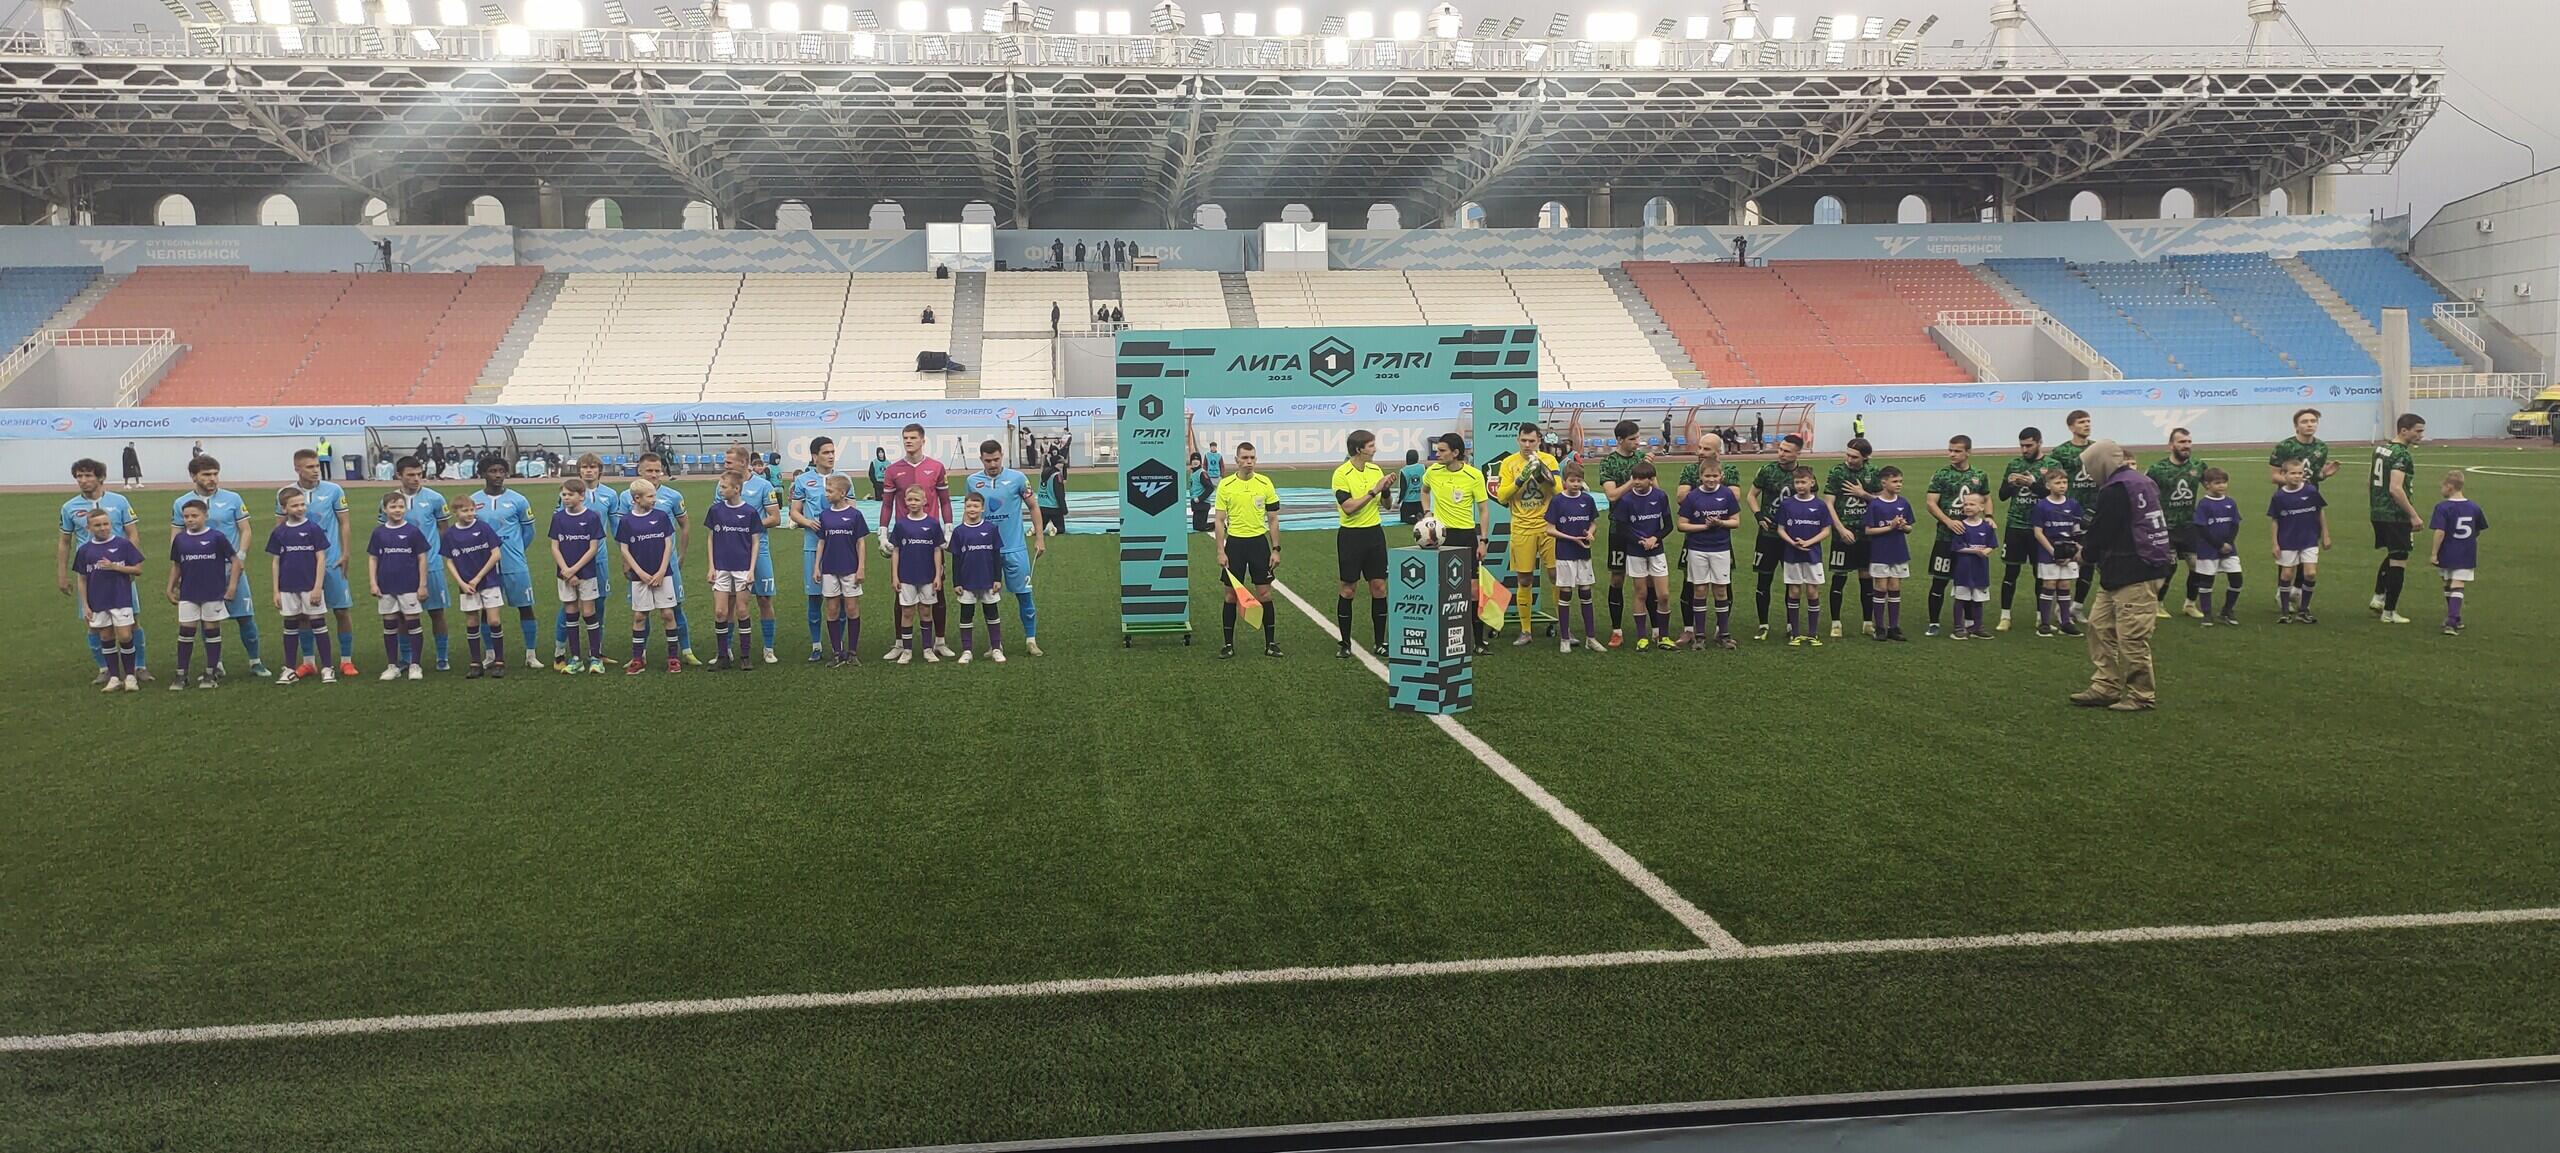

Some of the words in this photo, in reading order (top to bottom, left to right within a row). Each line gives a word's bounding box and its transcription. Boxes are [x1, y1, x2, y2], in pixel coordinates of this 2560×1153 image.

[1927, 243, 2003, 254] ЧЕЛЯБИНСК
[146, 249, 241, 260] ЧЕЛЯБИНСК
[1226, 354, 1302, 372] ЛИГА
[1362, 351, 1433, 370] PARI
[2036, 390, 2083, 401] Уралсиб
[2193, 388, 2239, 399] Уралсиб
[2343, 386, 2383, 396] Уралси
[1880, 393, 1926, 404] Уралсиб
[1225, 405, 1274, 415] Уралсиб
[1391, 402, 1440, 413] Уралсиб
[504, 414, 560, 425] Уралсиб
[875, 409, 928, 420] Уралсиб
[0, 418, 48, 427] ОРЭНЕРГО
[113, 417, 170, 429] Уралсиб
[309, 416, 366, 427] Уралсиб
[1488, 422, 1521, 432] PAR
[1132, 428, 1171, 438] PARI
[1200, 428, 1425, 456] ЧЕЛЯБИСК
[2374, 457, 2384, 487] 9
[2453, 516, 2473, 540] 5
[1611, 550, 1625, 566] 12
[1830, 550, 1846, 566] 10
[1934, 556, 1950, 573] 88
[761, 577, 775, 592] 77
[1394, 603, 1433, 614] PARI
[1442, 601, 1468, 615] PARI
[1402, 647, 1427, 656] MANIA
